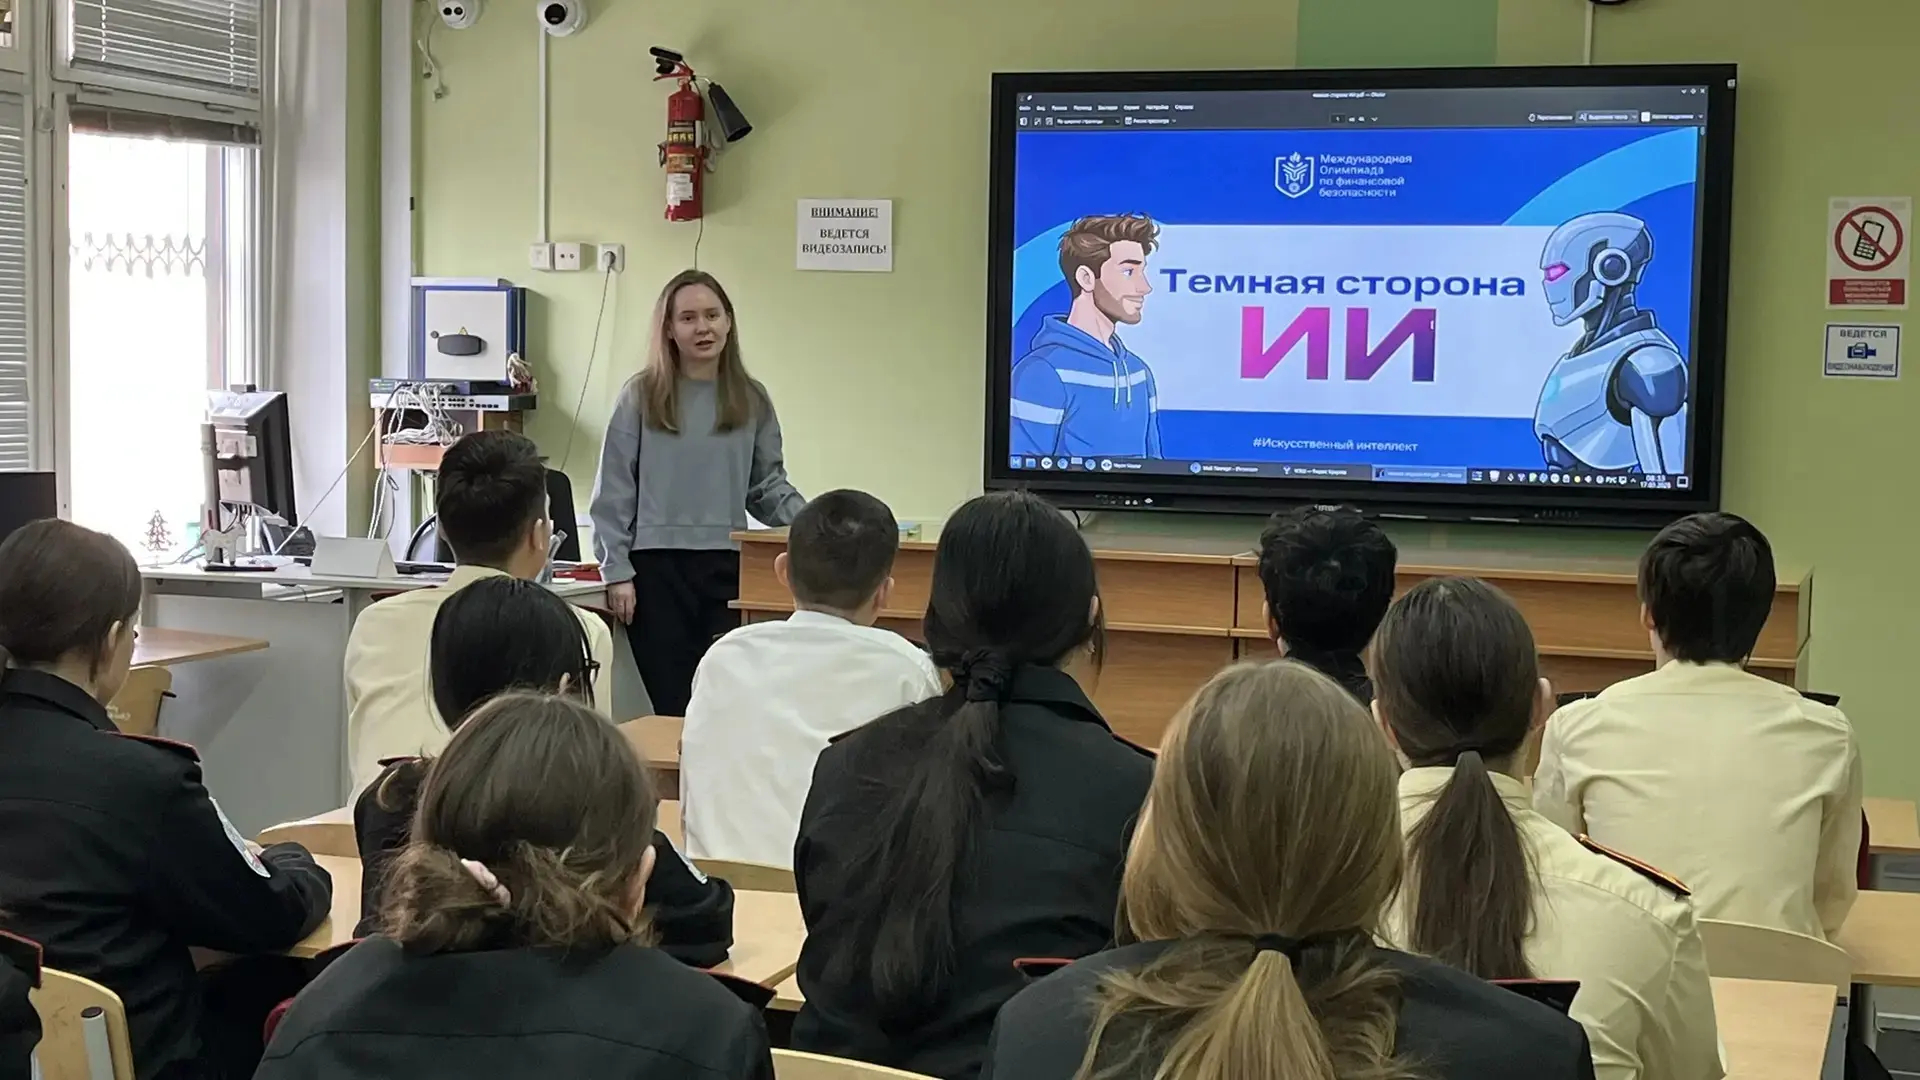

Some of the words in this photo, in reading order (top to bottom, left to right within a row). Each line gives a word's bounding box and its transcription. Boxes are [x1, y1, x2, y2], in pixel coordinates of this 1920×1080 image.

[1320, 154, 1413, 165] Международная
[1320, 166, 1384, 176] Олимпиада
[1319, 178, 1334, 186] по
[1335, 176, 1405, 187] финансовой
[1319, 187, 1397, 198] безопасности
[811, 207, 879, 218] ВНИМАНИЕ!
[820, 229, 870, 240] ВЕДЕТСЯ
[802, 244, 887, 254] ВИДЕОЗАПИСЬ!
[1159, 268, 1325, 294] Темная
[1336, 274, 1526, 302] сторона
[1840, 329, 1888, 339] ВЕДЕТСЯ
[1240, 305, 1437, 382] ИИ
[1253, 437, 1354, 450] #Искусственный
[1356, 442, 1418, 453] интеллект
